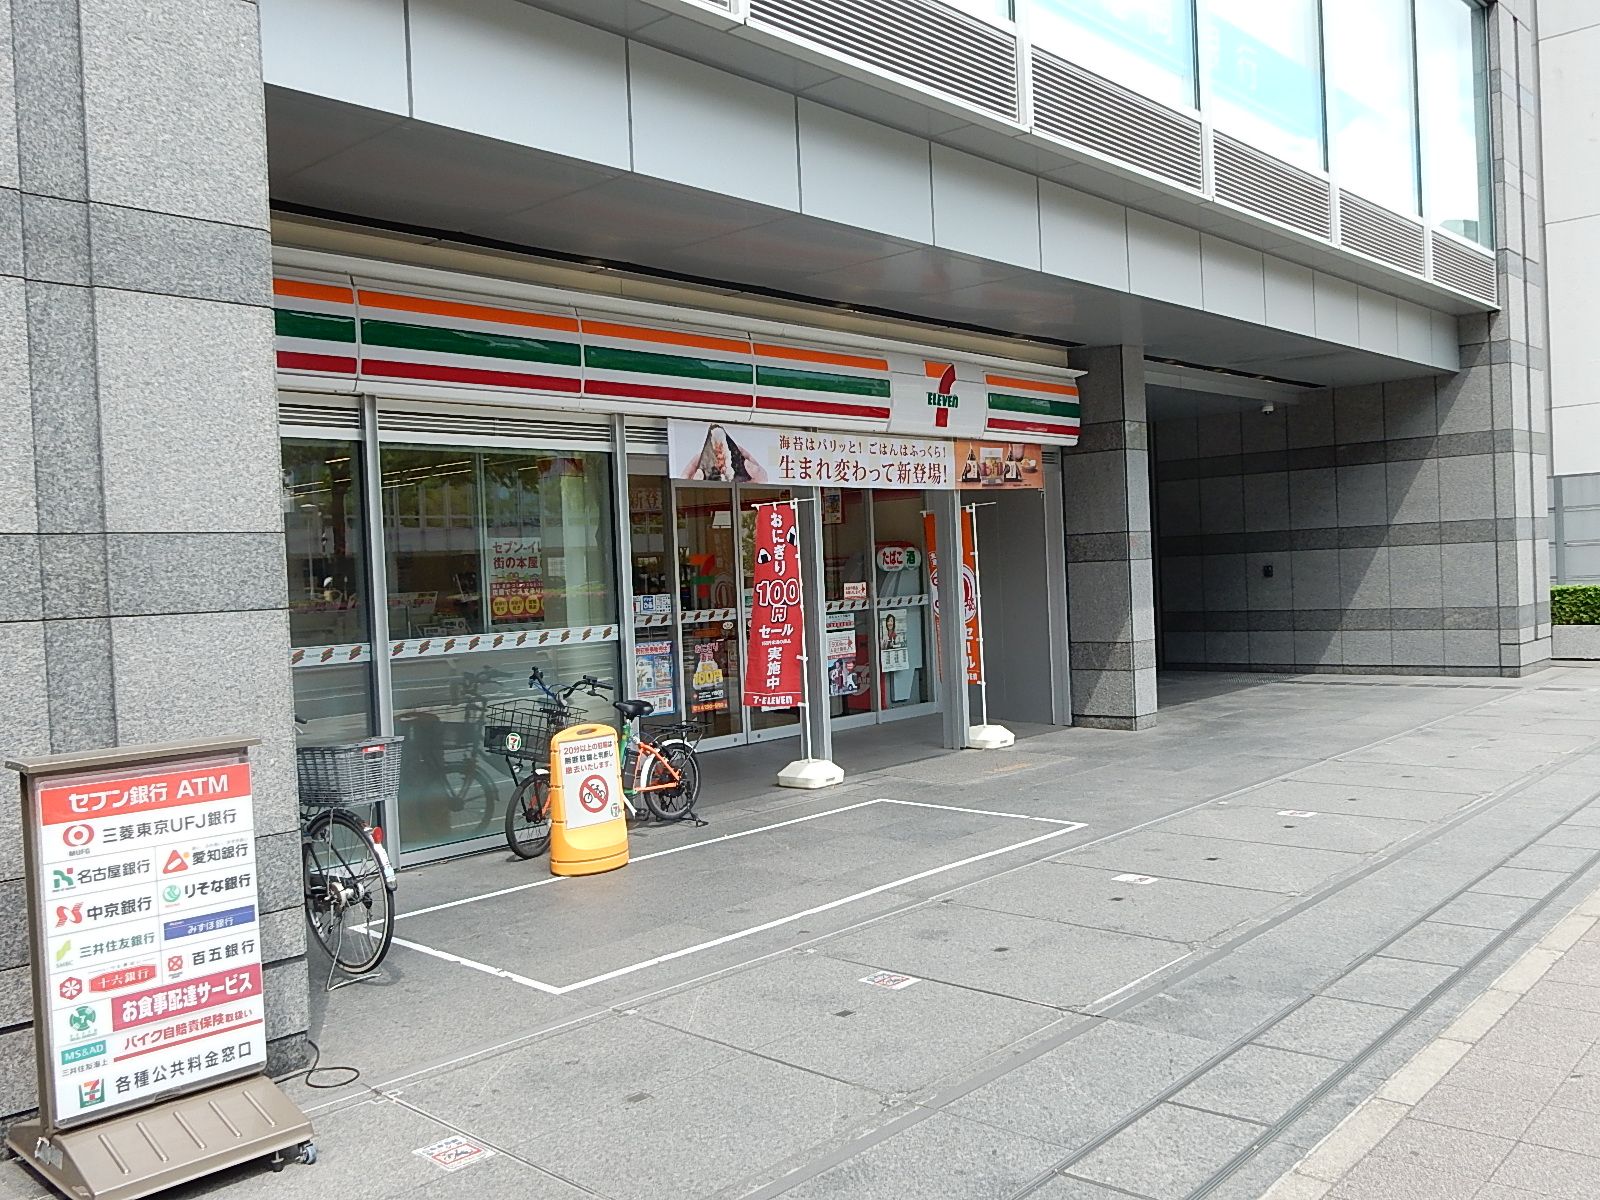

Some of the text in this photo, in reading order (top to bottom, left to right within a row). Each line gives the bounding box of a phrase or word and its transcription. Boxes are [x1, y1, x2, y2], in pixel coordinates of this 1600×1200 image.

[926, 392, 959, 408] ELEVEN
[778, 455, 948, 485] 生まれ変わって新登場!
[770, 512, 787, 576] おにぎり
[882, 550, 904, 566] たばこ
[756, 578, 800, 606] 100
[771, 604, 788, 623] 円
[758, 623, 794, 639] セール
[766, 646, 783, 690] 実施中
[752, 695, 793, 705] 7-ELEVEN
[68, 774, 229, 813] セブン銀行 ATM
[102, 808, 237, 845] 三菱東京UFJ銀行
[192, 843, 249, 866] 愛知銀行
[77, 859, 151, 885] 名古屋銀行
[184, 873, 251, 899] りそな銀行
[86, 896, 153, 921] 中京銀行
[79, 931, 156, 959] 三井住友銀行
[192, 939, 256, 966] 百五銀行
[98, 969, 150, 989] 十六銀行
[122, 971, 253, 1023] お食事配達サービス
[64, 1044, 104, 1061] MS&AD
[115, 1041, 252, 1094] 各種公共料金窓口
